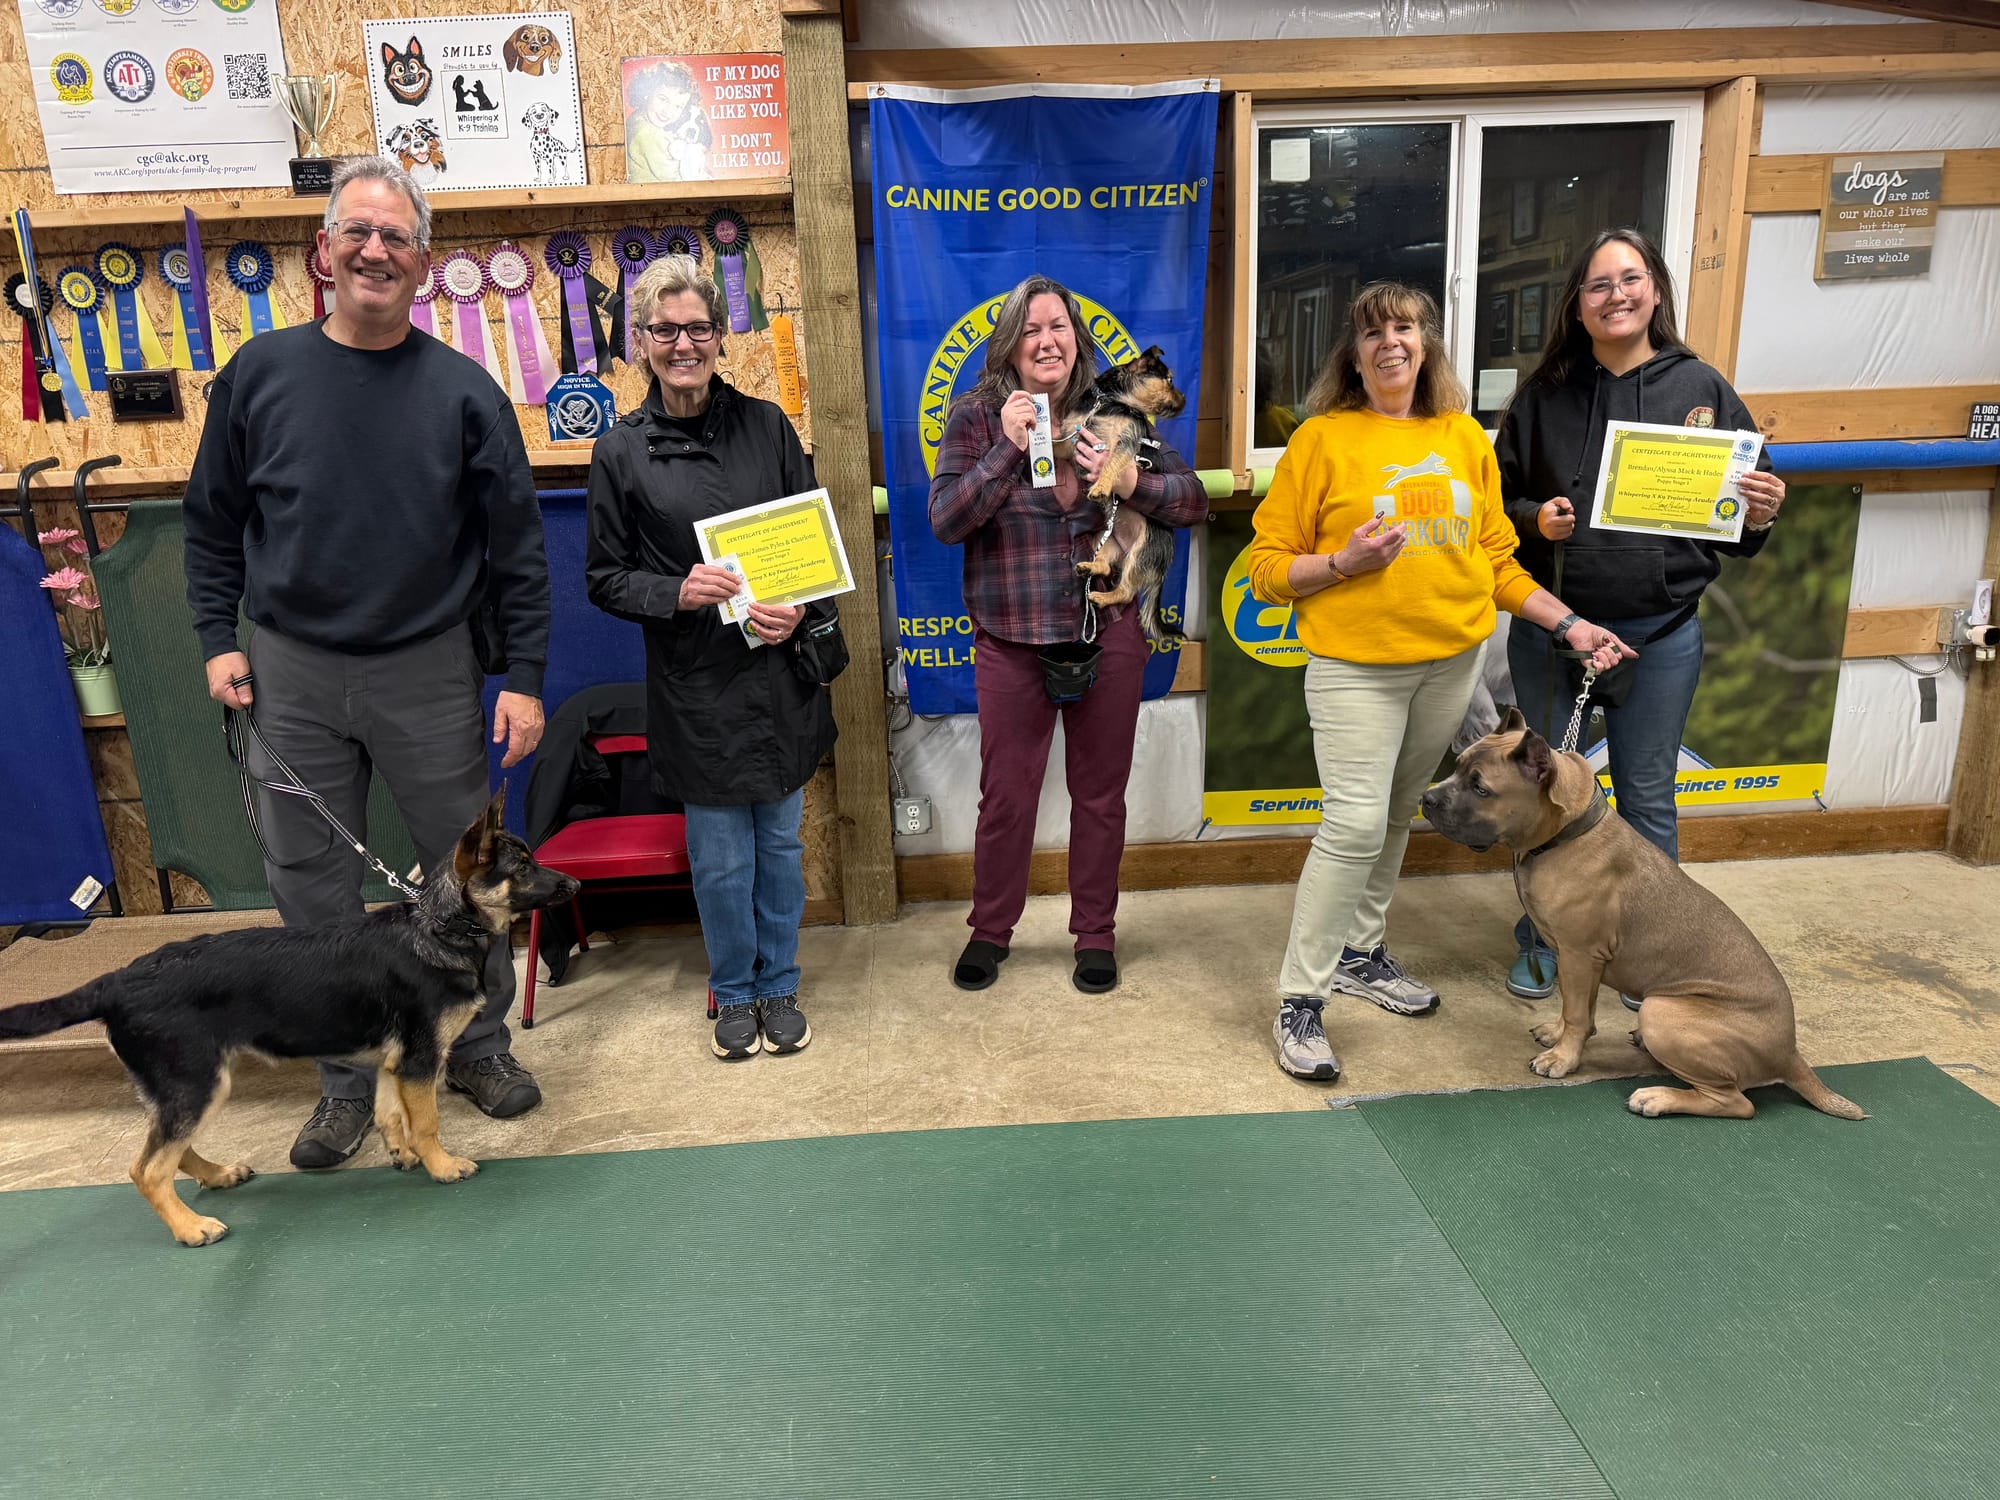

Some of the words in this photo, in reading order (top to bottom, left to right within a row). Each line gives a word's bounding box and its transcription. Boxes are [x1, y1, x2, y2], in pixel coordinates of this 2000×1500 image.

[442, 44, 493, 58] SMILES
[119, 63, 140, 86] ATT
[705, 66, 721, 81] IF
[724, 65, 746, 80] MY
[751, 64, 780, 79] DOG
[714, 83, 773, 100] DOESN'T
[710, 104, 747, 119] LIKE
[749, 102, 782, 118] YOU.
[457, 114, 493, 123] Whispering
[458, 124, 471, 132] K-9
[472, 122, 499, 132] Training
[721, 134, 727, 149] I
[730, 132, 772, 148] DON'T
[136, 151, 210, 167] cgc@akc.org
[712, 152, 748, 168] LIKE
[751, 151, 784, 166] YOU.
[94, 164, 257, 177] www.AKC.org/sports/akc-family-dog-program/
[1844, 161, 1908, 206] dogs
[886, 185, 991, 211] CANINE
[997, 187, 1082, 211] GOOD
[1888, 192, 1908, 201] are
[1911, 189, 1931, 200] not
[1839, 210, 1859, 219] our
[1863, 207, 1895, 218] whole
[1898, 206, 1929, 217] lives
[1859, 222, 1877, 233] but
[1880, 221, 1907, 234] they
[1855, 236, 1881, 248] make
[1884, 237, 1905, 246] our
[1844, 253, 1874, 265] lives
[1878, 252, 1910, 263] whole
[563, 376, 591, 384] NOVICE
[924, 320, 982, 449] CANINE
[1974, 405, 1980, 414] A
[1981, 405, 1999, 415] DOG
[1970, 423, 2000, 438] HEA
[1631, 448, 1671, 457] CERTIFICATE
[1681, 451, 1726, 461] ACHIEVEMENT
[1734, 451, 1756, 460] AMERICAN
[1627, 464, 1676, 474] Brendan/Alyssa
[1618, 490, 1651, 499] Whispering
[1401, 488, 1448, 517] DOG
[726, 530, 762, 544] CERTIFICATE
[770, 518, 808, 532] ACHIEVEMENT
[776, 565, 799, 575] Training
[1675, 779, 1727, 793] since
[1733, 775, 1780, 790] 1995
